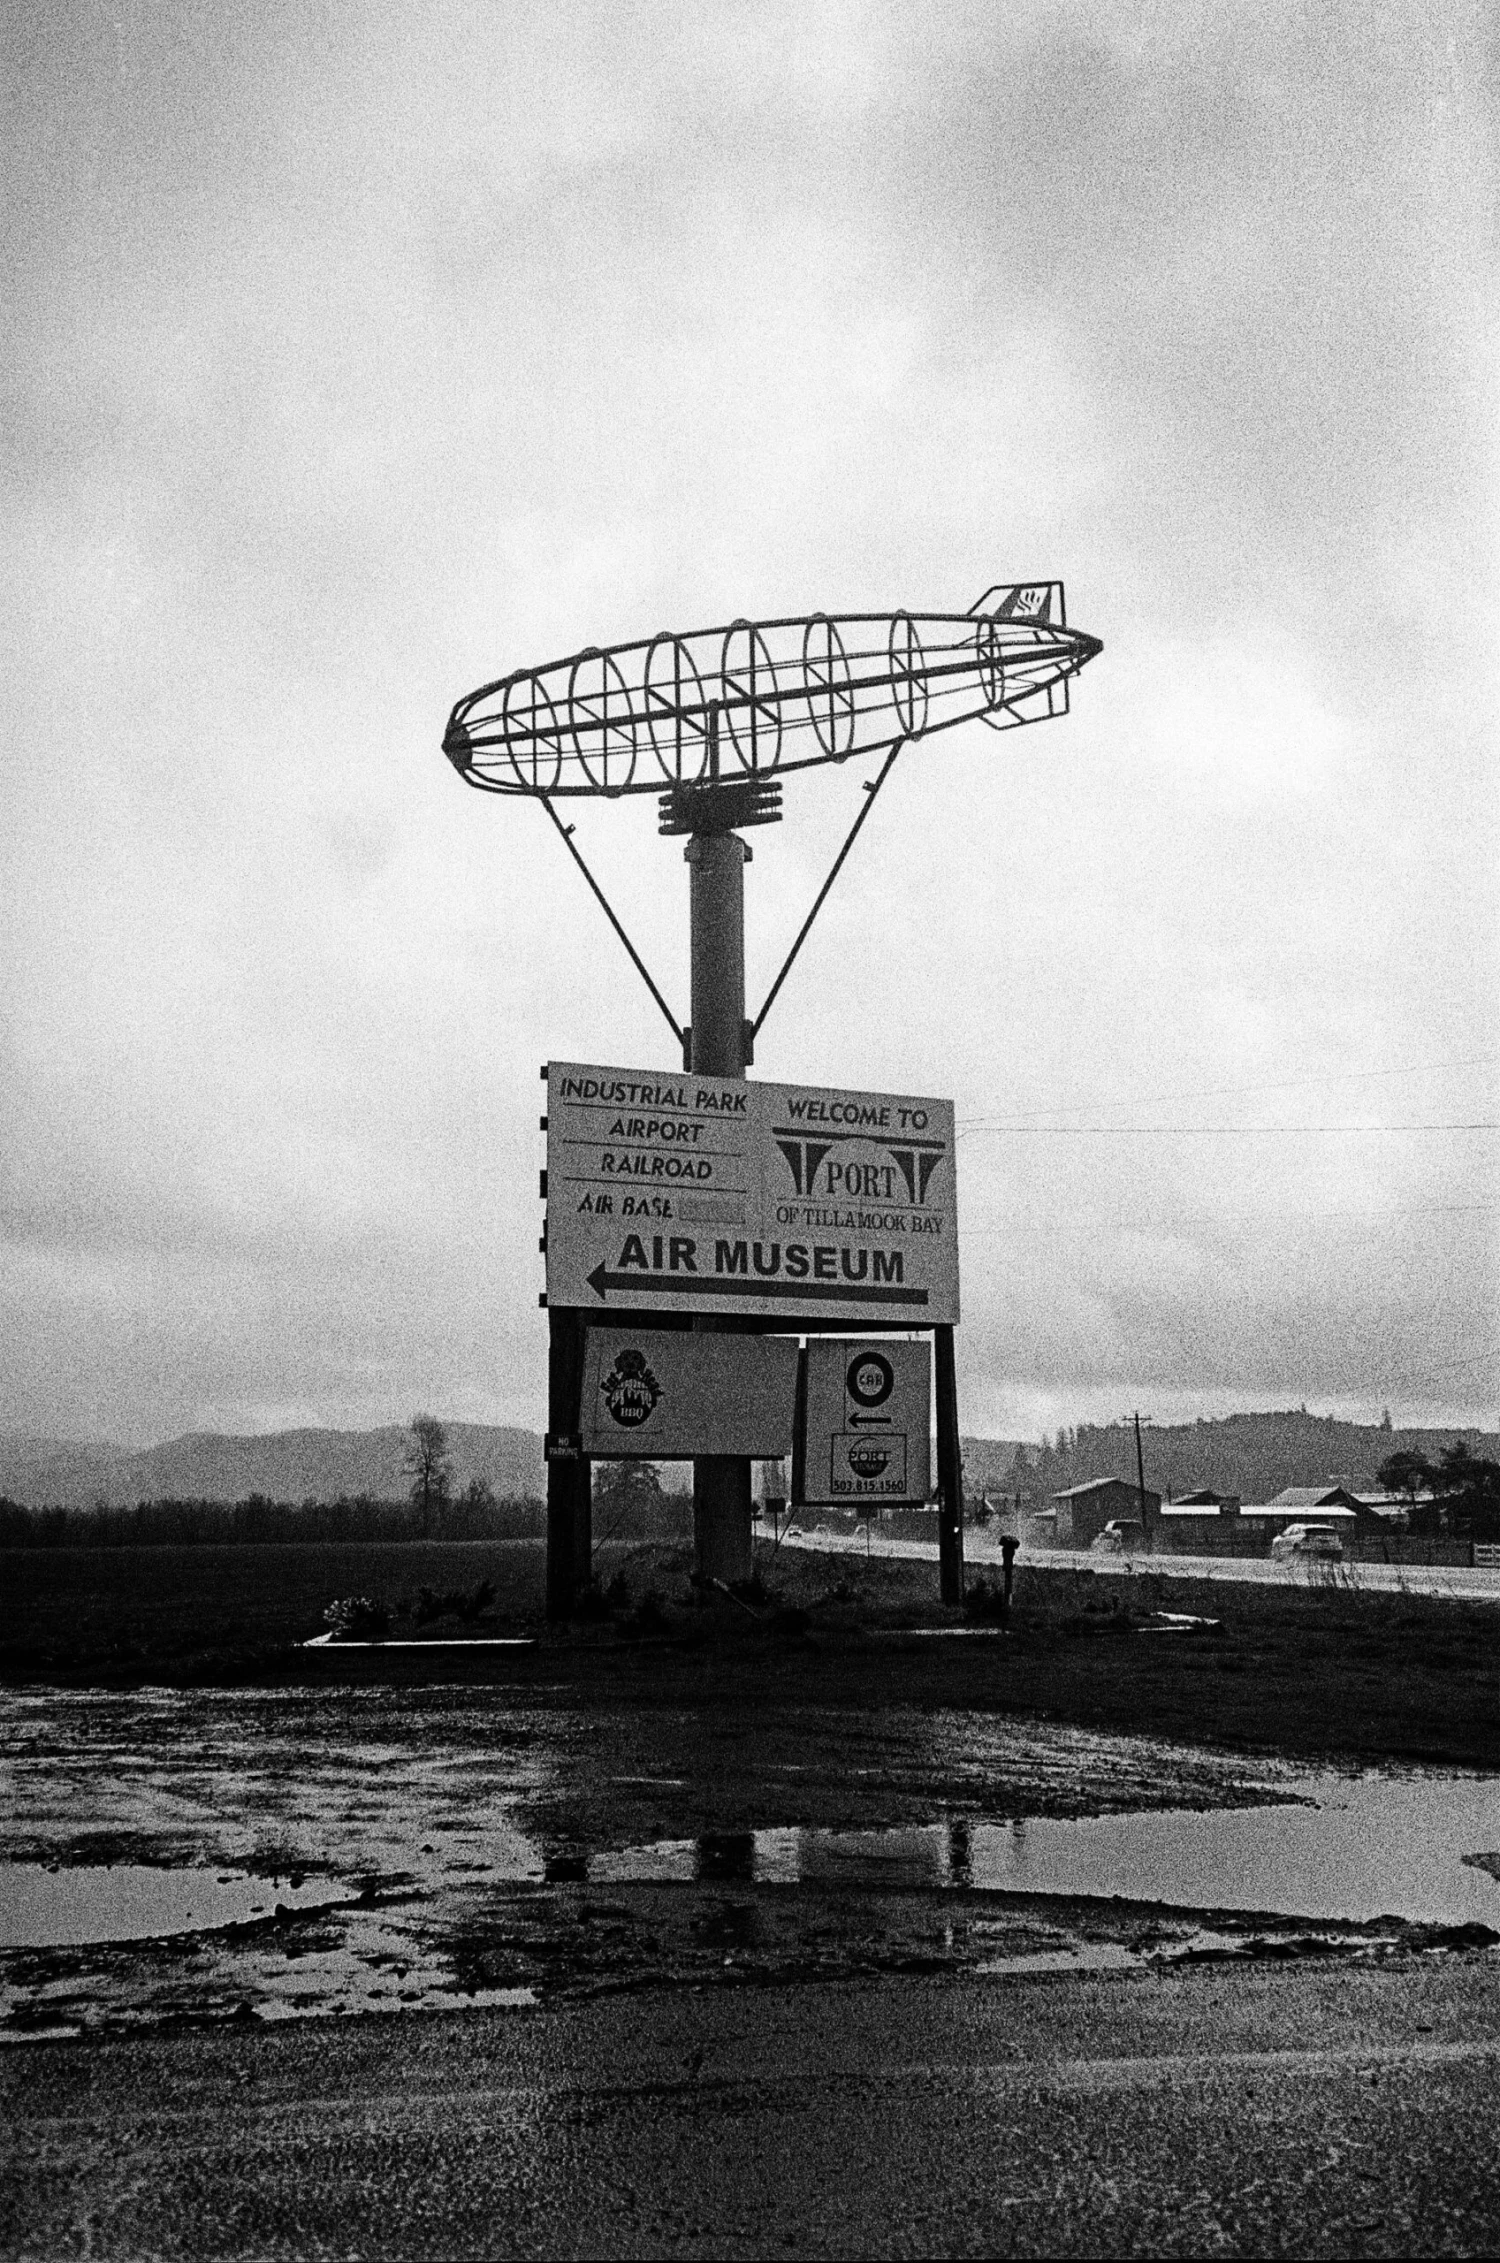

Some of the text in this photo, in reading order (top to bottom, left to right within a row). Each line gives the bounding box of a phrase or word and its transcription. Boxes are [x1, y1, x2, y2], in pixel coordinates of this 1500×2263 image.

[559, 1078, 747, 1112] INDUSTRIAL PARK
[787, 1100, 928, 1130] WELCOME TO
[608, 1118, 704, 1143] AIRPORT
[601, 1153, 712, 1179] RAILROAD
[826, 1161, 896, 1198] PORT
[577, 1193, 673, 1218] AIR BASE
[776, 1206, 944, 1233] OF TILLAMOOK BAY
[617, 1233, 904, 1283] AIR MUSEUM
[620, 1408, 644, 1419] BBQ
[549, 1447, 578, 1458] PARKING
[558, 1437, 569, 1446] NO
[848, 1451, 892, 1462] PORT
